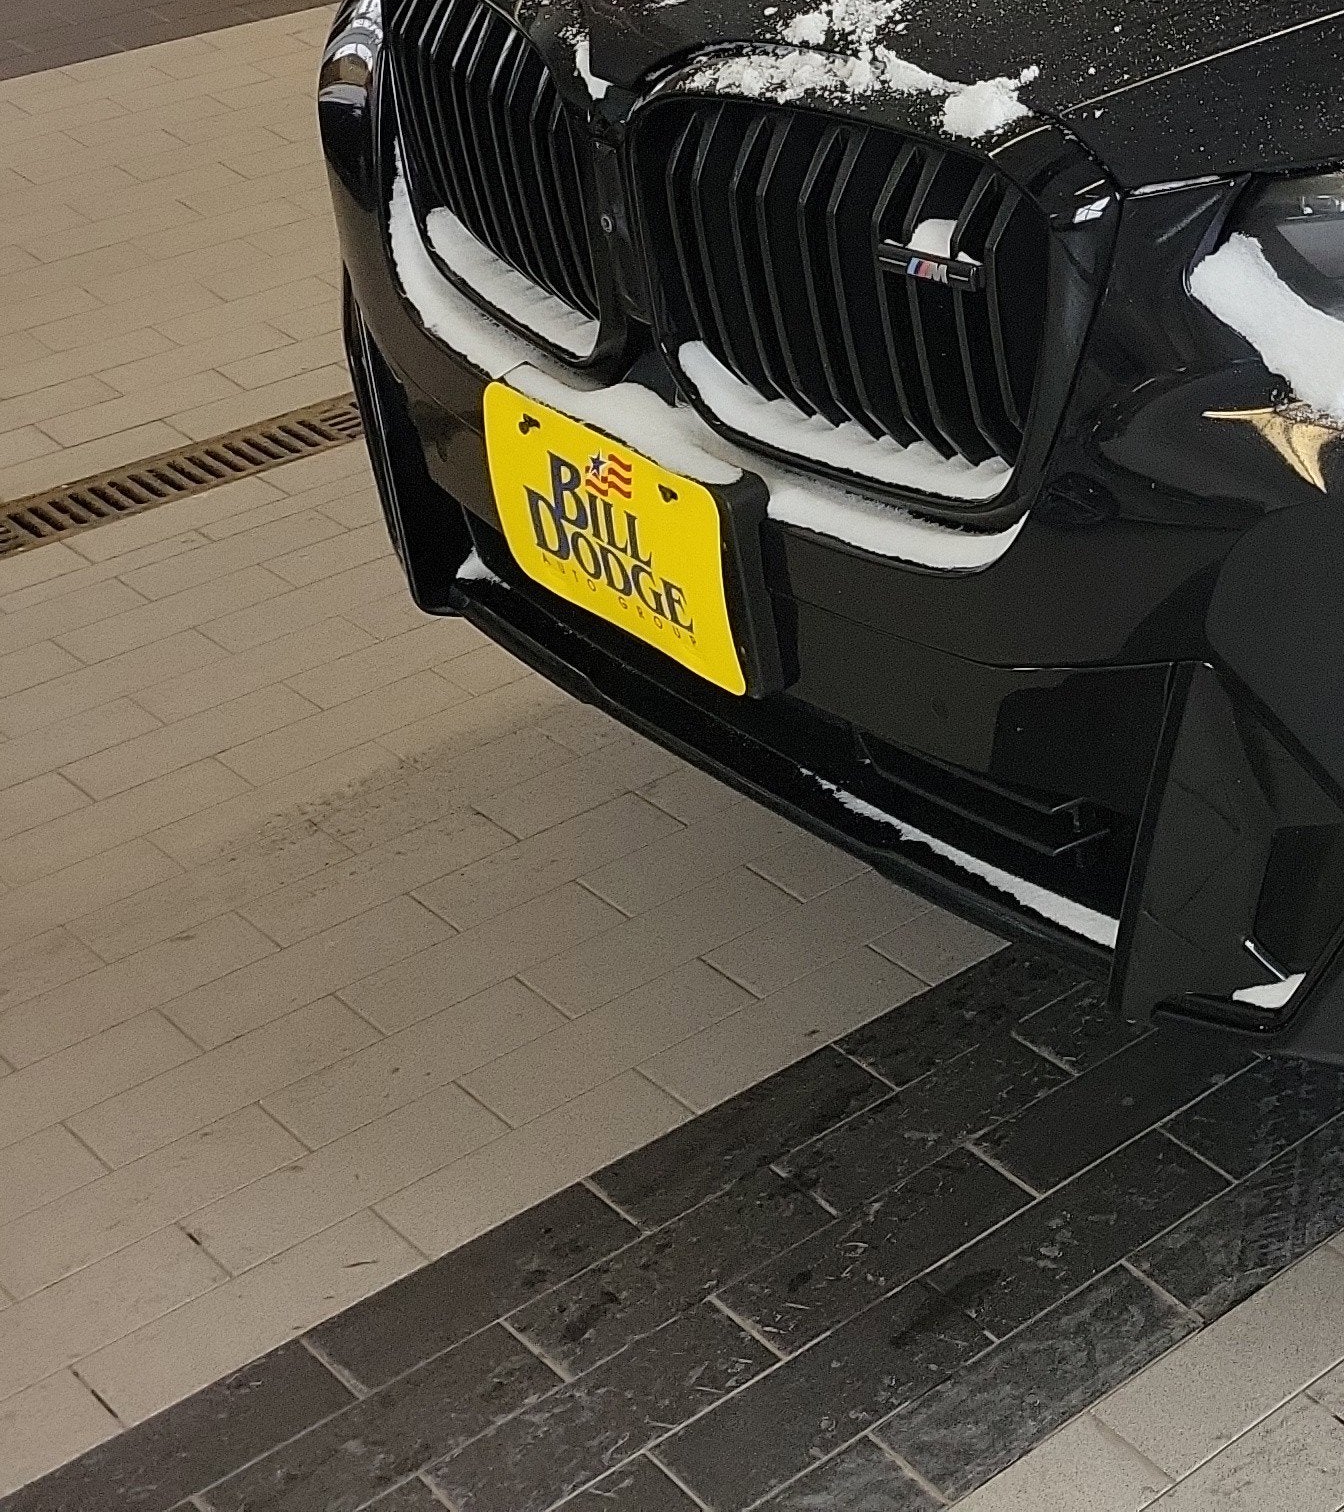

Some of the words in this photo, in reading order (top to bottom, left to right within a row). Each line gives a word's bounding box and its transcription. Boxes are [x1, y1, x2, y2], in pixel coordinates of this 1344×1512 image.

[523, 484, 694, 634] DODGE
[547, 449, 652, 571] BILL
[542, 555, 597, 593] AUTO
[618, 595, 697, 647] GROUP
